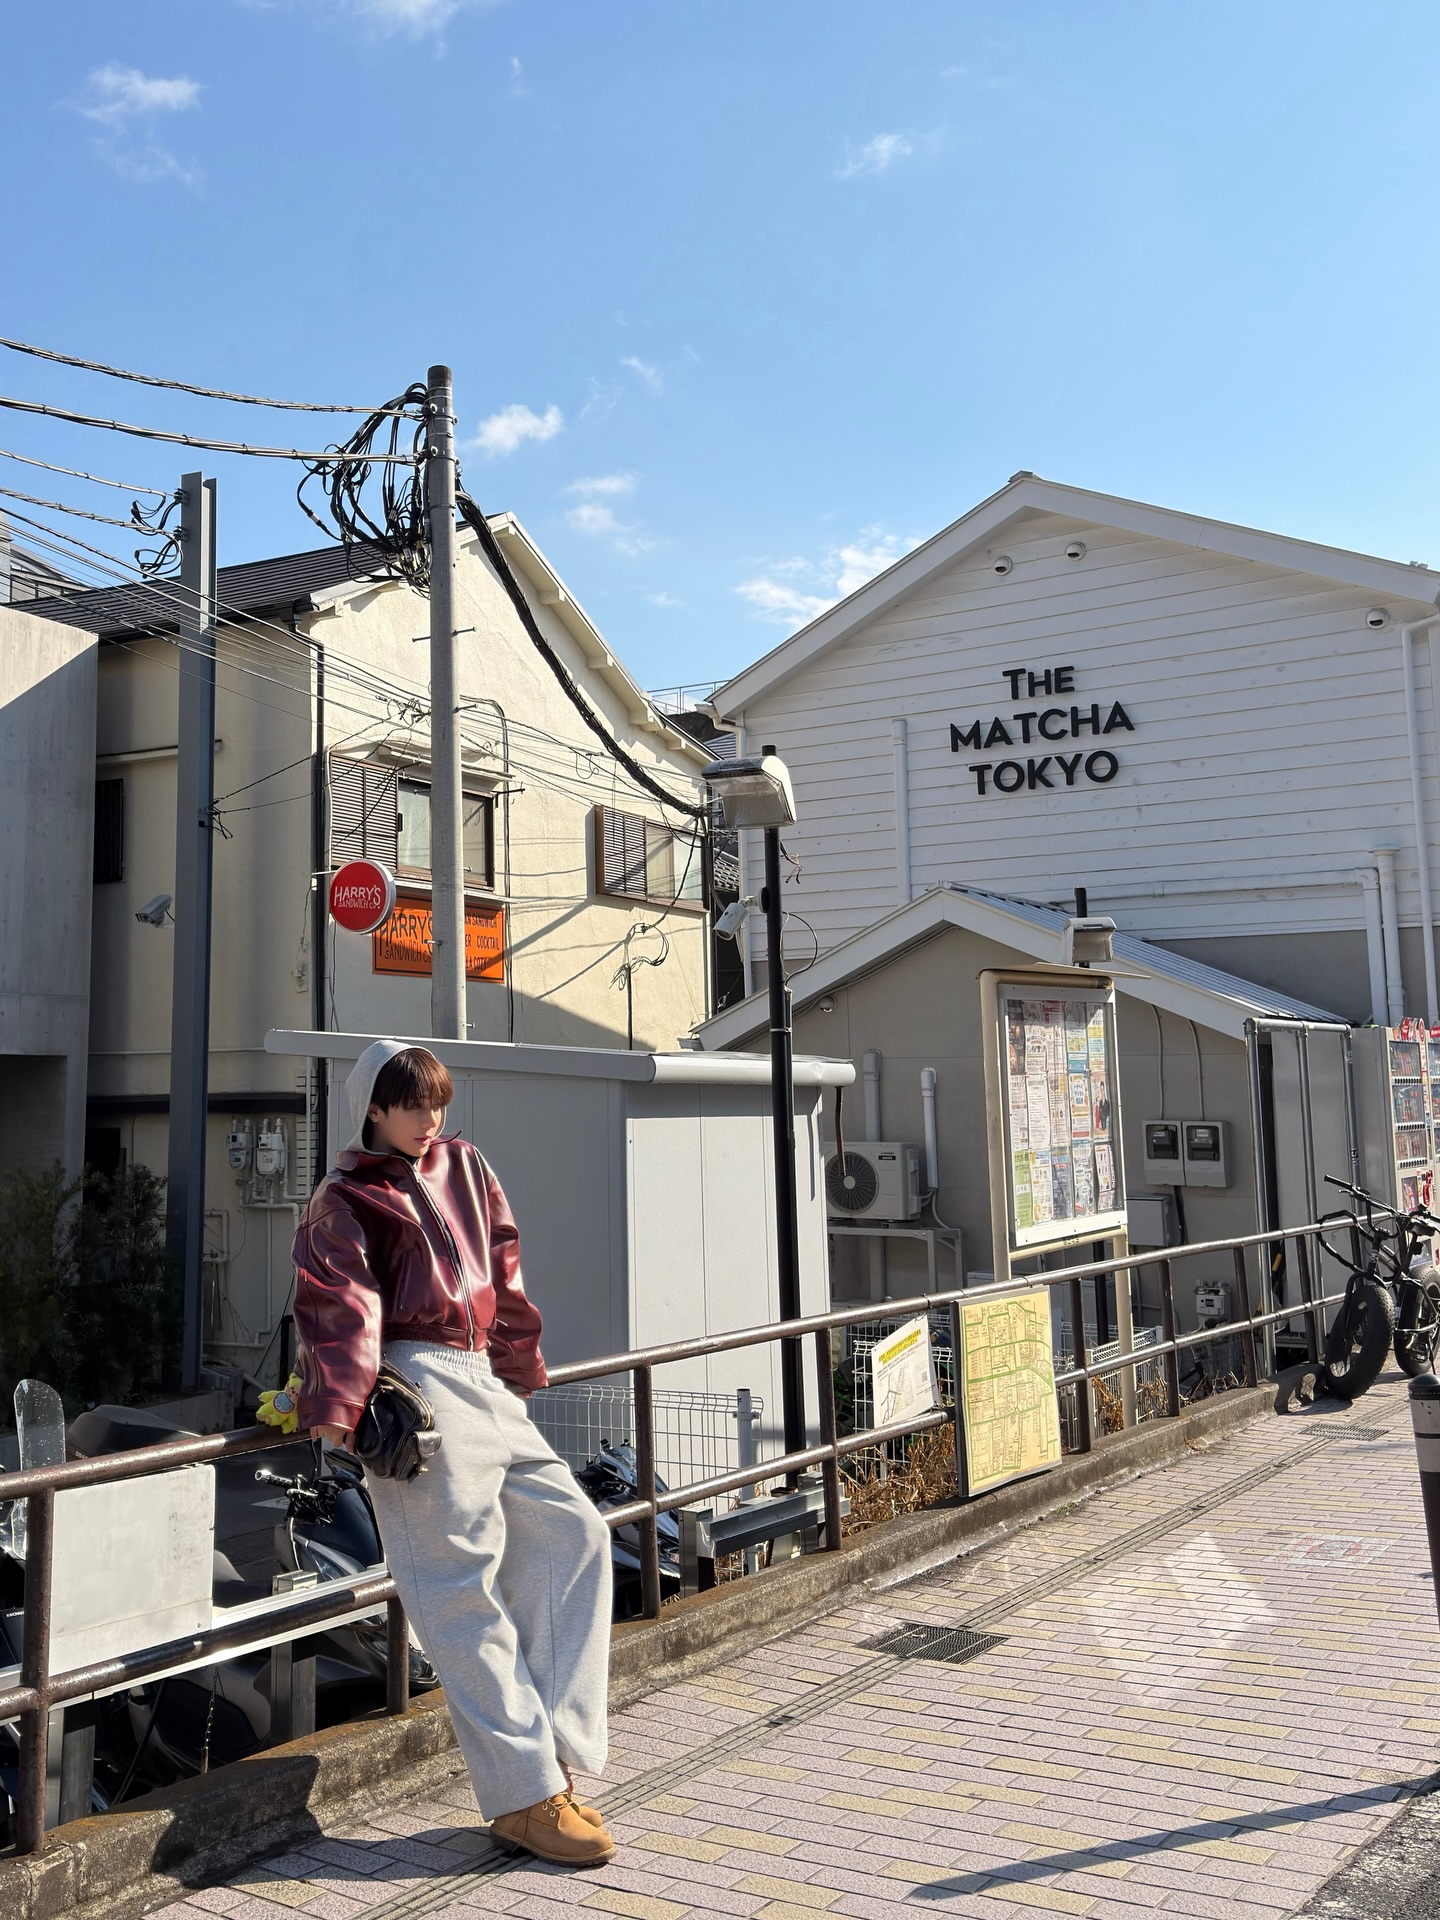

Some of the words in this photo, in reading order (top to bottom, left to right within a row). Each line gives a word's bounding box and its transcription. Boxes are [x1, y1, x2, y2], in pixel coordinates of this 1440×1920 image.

[1002, 665, 1075, 700] THE
[950, 700, 1135, 752] MATCHA
[968, 750, 1119, 795] TOKYO
[334, 884, 381, 907] HARRY'S
[338, 897, 368, 908] SANDWICH
[472, 913, 497, 928] SANDWICH
[384, 939, 422, 963] SANDWICH
[477, 935, 500, 950] COCKTAIL
